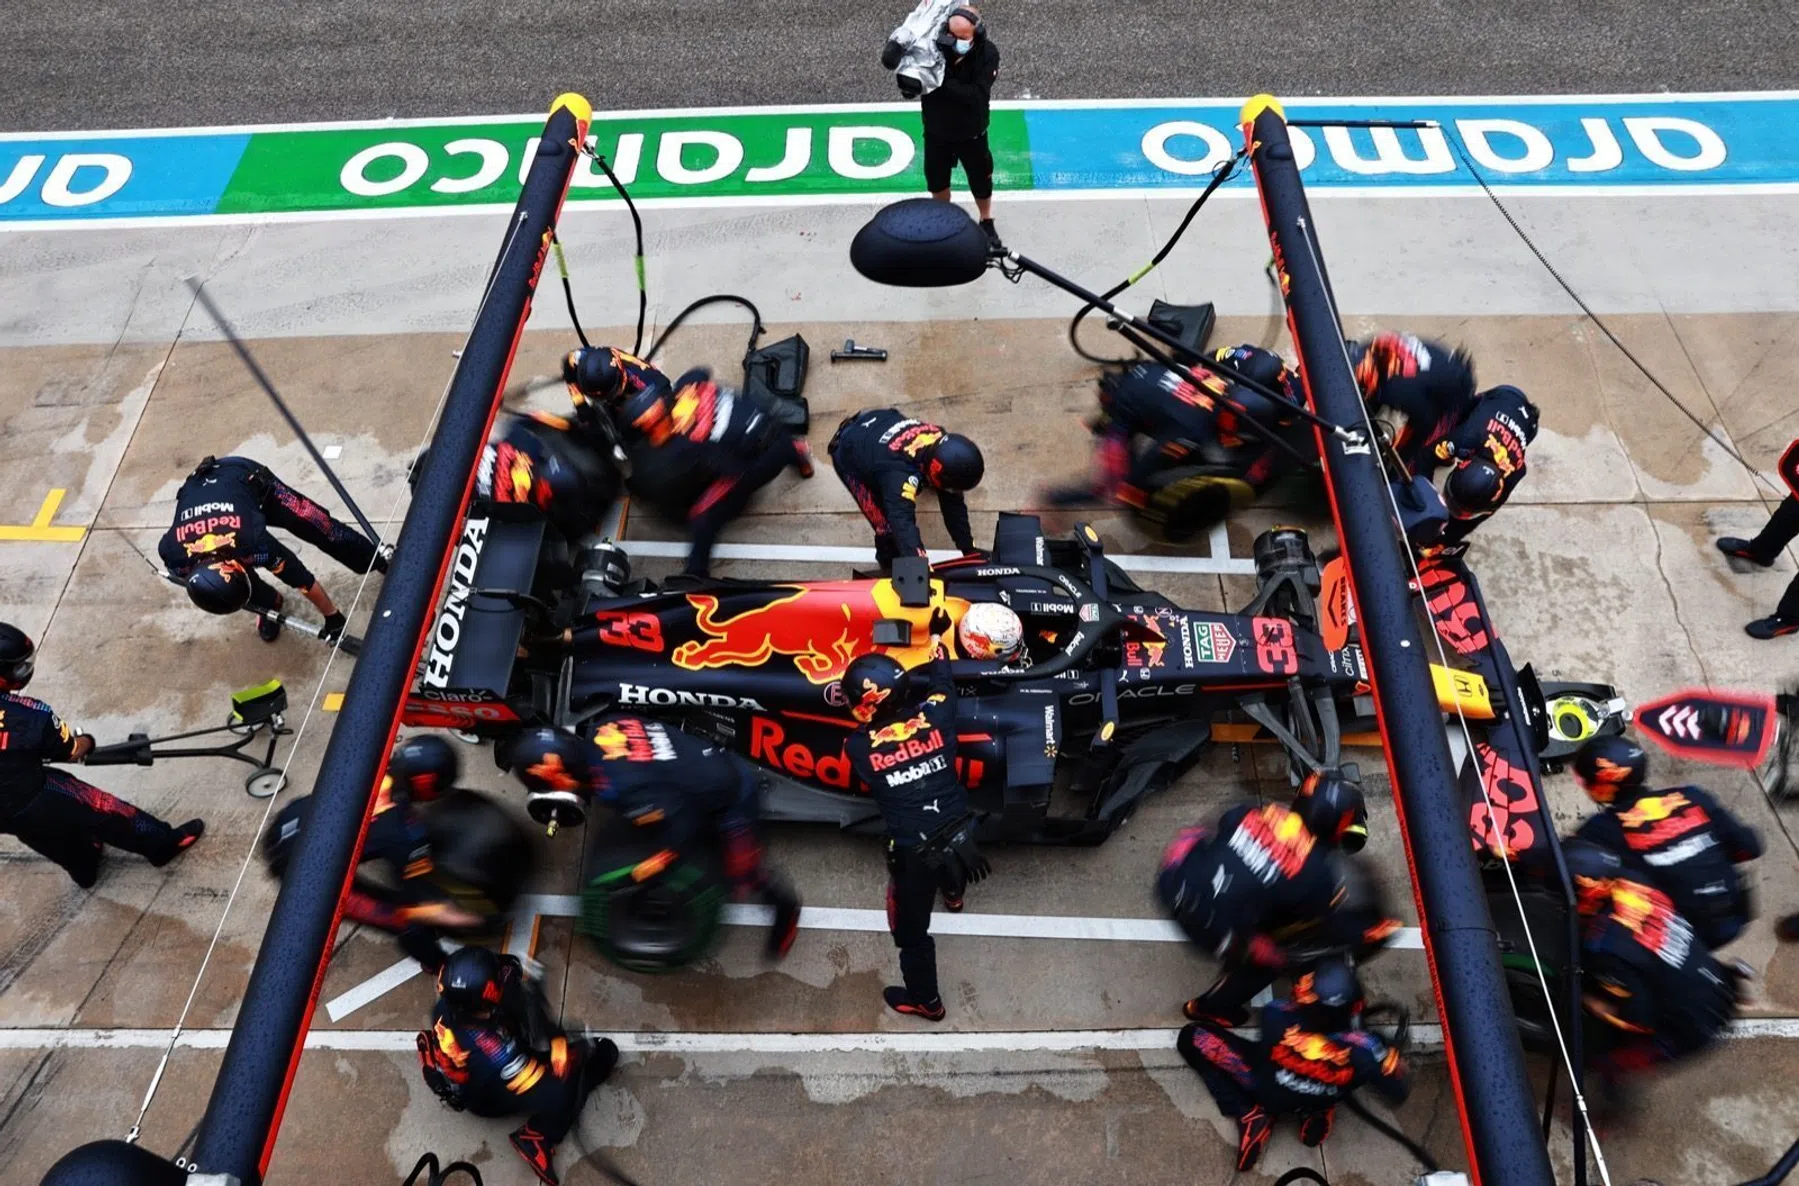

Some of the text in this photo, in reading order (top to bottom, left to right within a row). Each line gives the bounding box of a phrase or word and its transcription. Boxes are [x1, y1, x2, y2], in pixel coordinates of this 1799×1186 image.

[340, 126, 915, 197] aramco
[1486, 419, 1513, 447] Bull
[194, 502, 234, 517] Mobil
[176, 515, 242, 543] Red Bull
[976, 567, 1021, 577] HONDA
[1058, 574, 1083, 599] ORACLE
[423, 516, 490, 688] HONDA
[1043, 602, 1074, 614] Mobil
[596, 611, 665, 653] 33
[1180, 615, 1194, 669] HONDA
[1198, 625, 1212, 660] TAG
[1126, 642, 1144, 667] Bull
[424, 688, 484, 703] Claro
[618, 683, 768, 711] HONDA
[1044, 704, 1056, 745] Walmart
[751, 716, 852, 788] Red
[869, 728, 945, 772] Red Bull
[885, 761, 932, 788] Mobil
